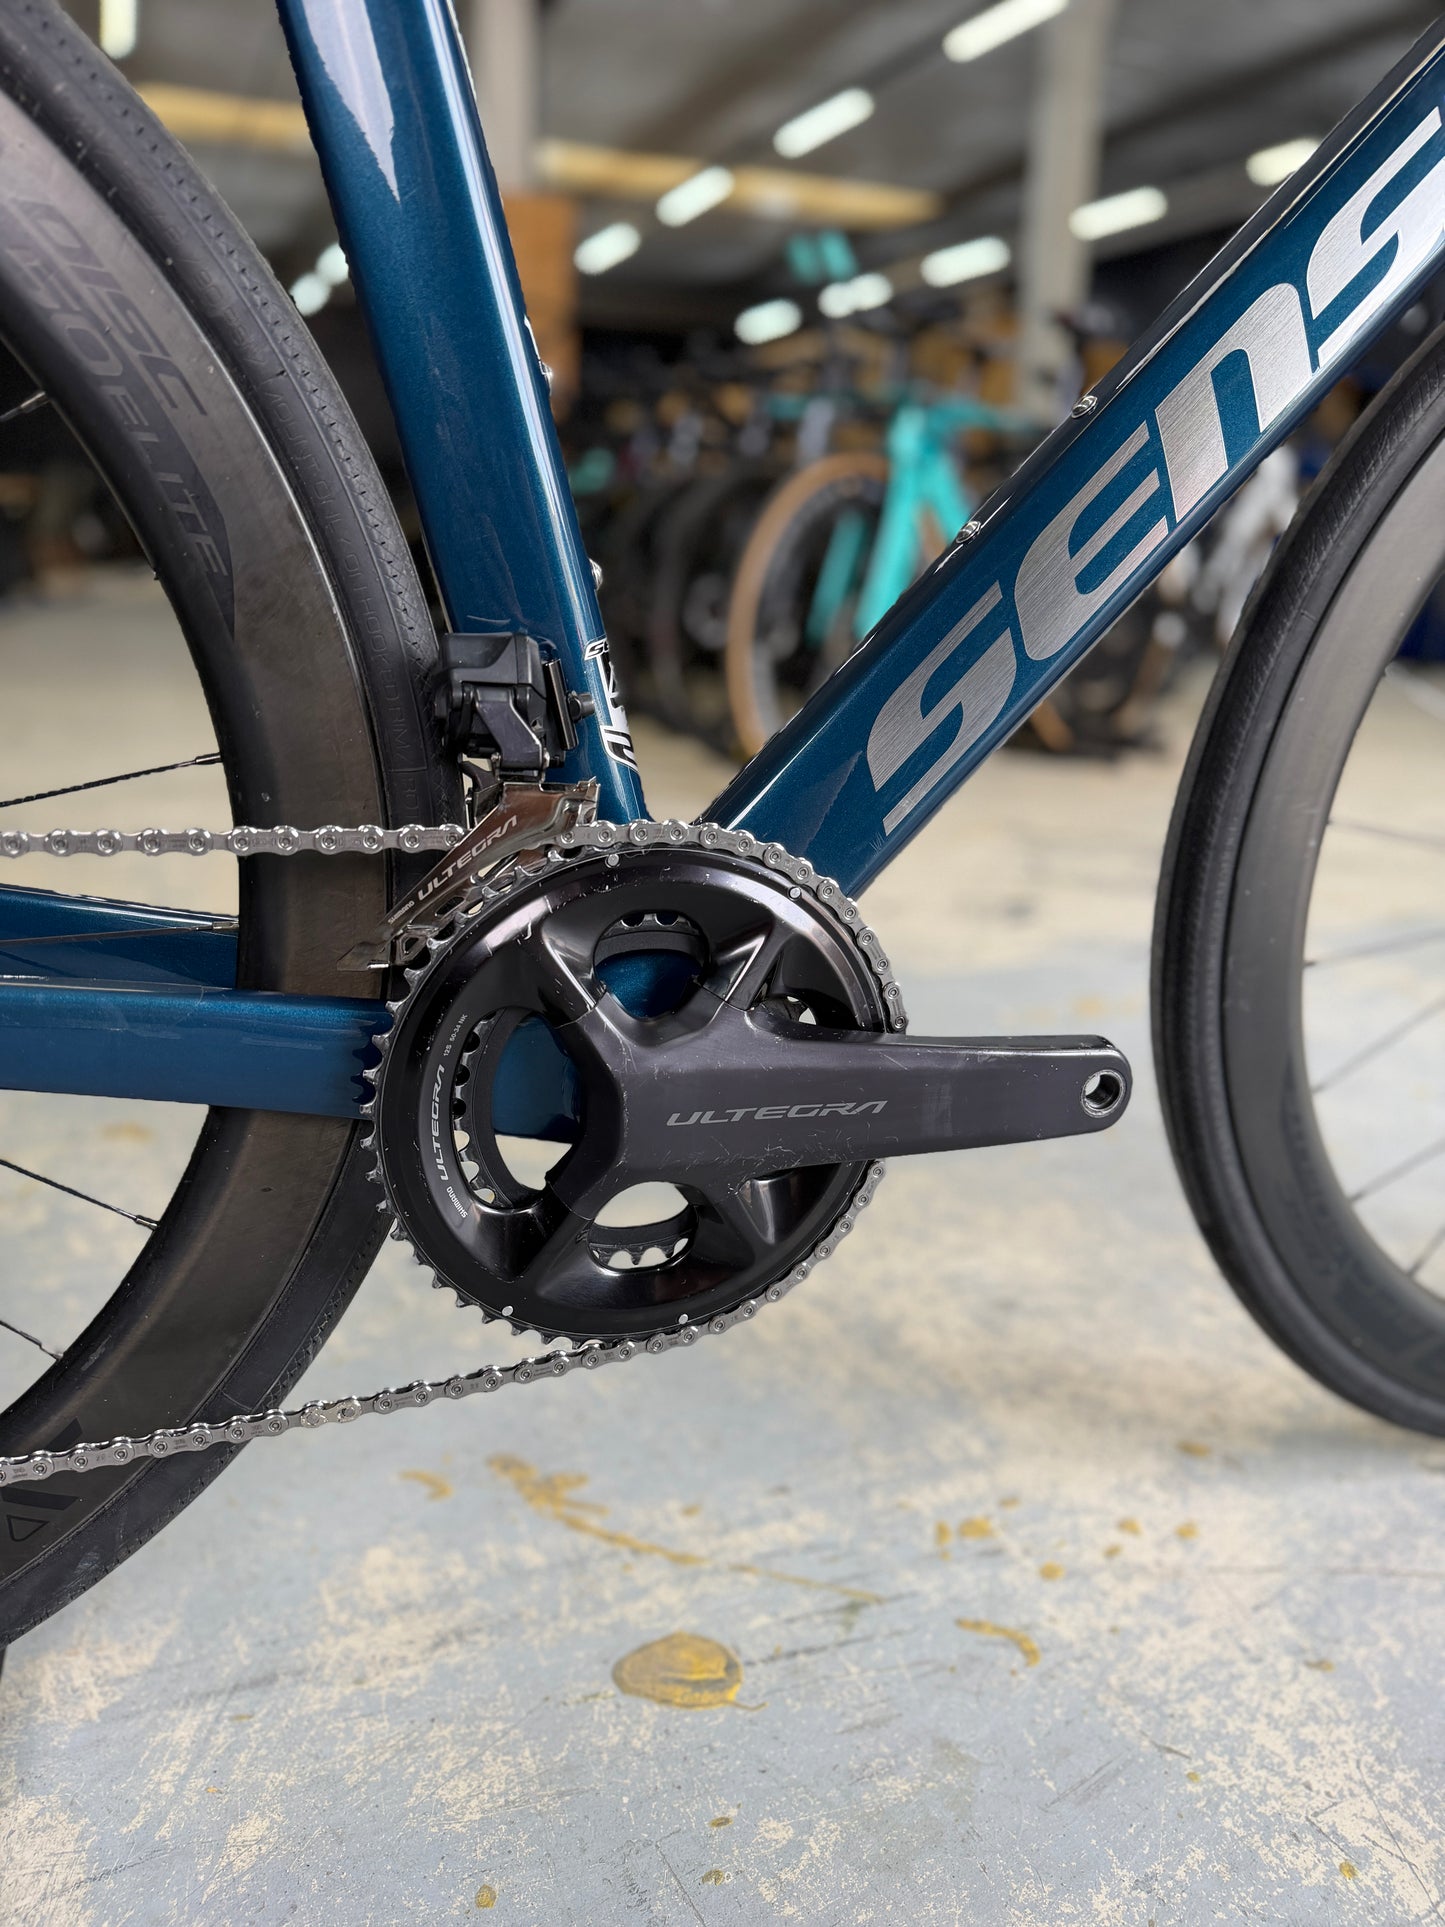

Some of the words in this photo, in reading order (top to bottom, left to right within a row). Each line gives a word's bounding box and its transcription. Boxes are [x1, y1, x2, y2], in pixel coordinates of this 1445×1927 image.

[16, 202, 208, 416] DISC
[101, 385, 229, 576] ELITE
[388, 901, 414, 924] SHIMANO
[417, 815, 518, 901] ULTEGRA
[443, 1044, 452, 1056] 12S
[431, 1064, 449, 1180] ULTEGRA
[666, 1100, 888, 1126] ULTEGRA
[446, 1186, 468, 1218] SHIMANO
